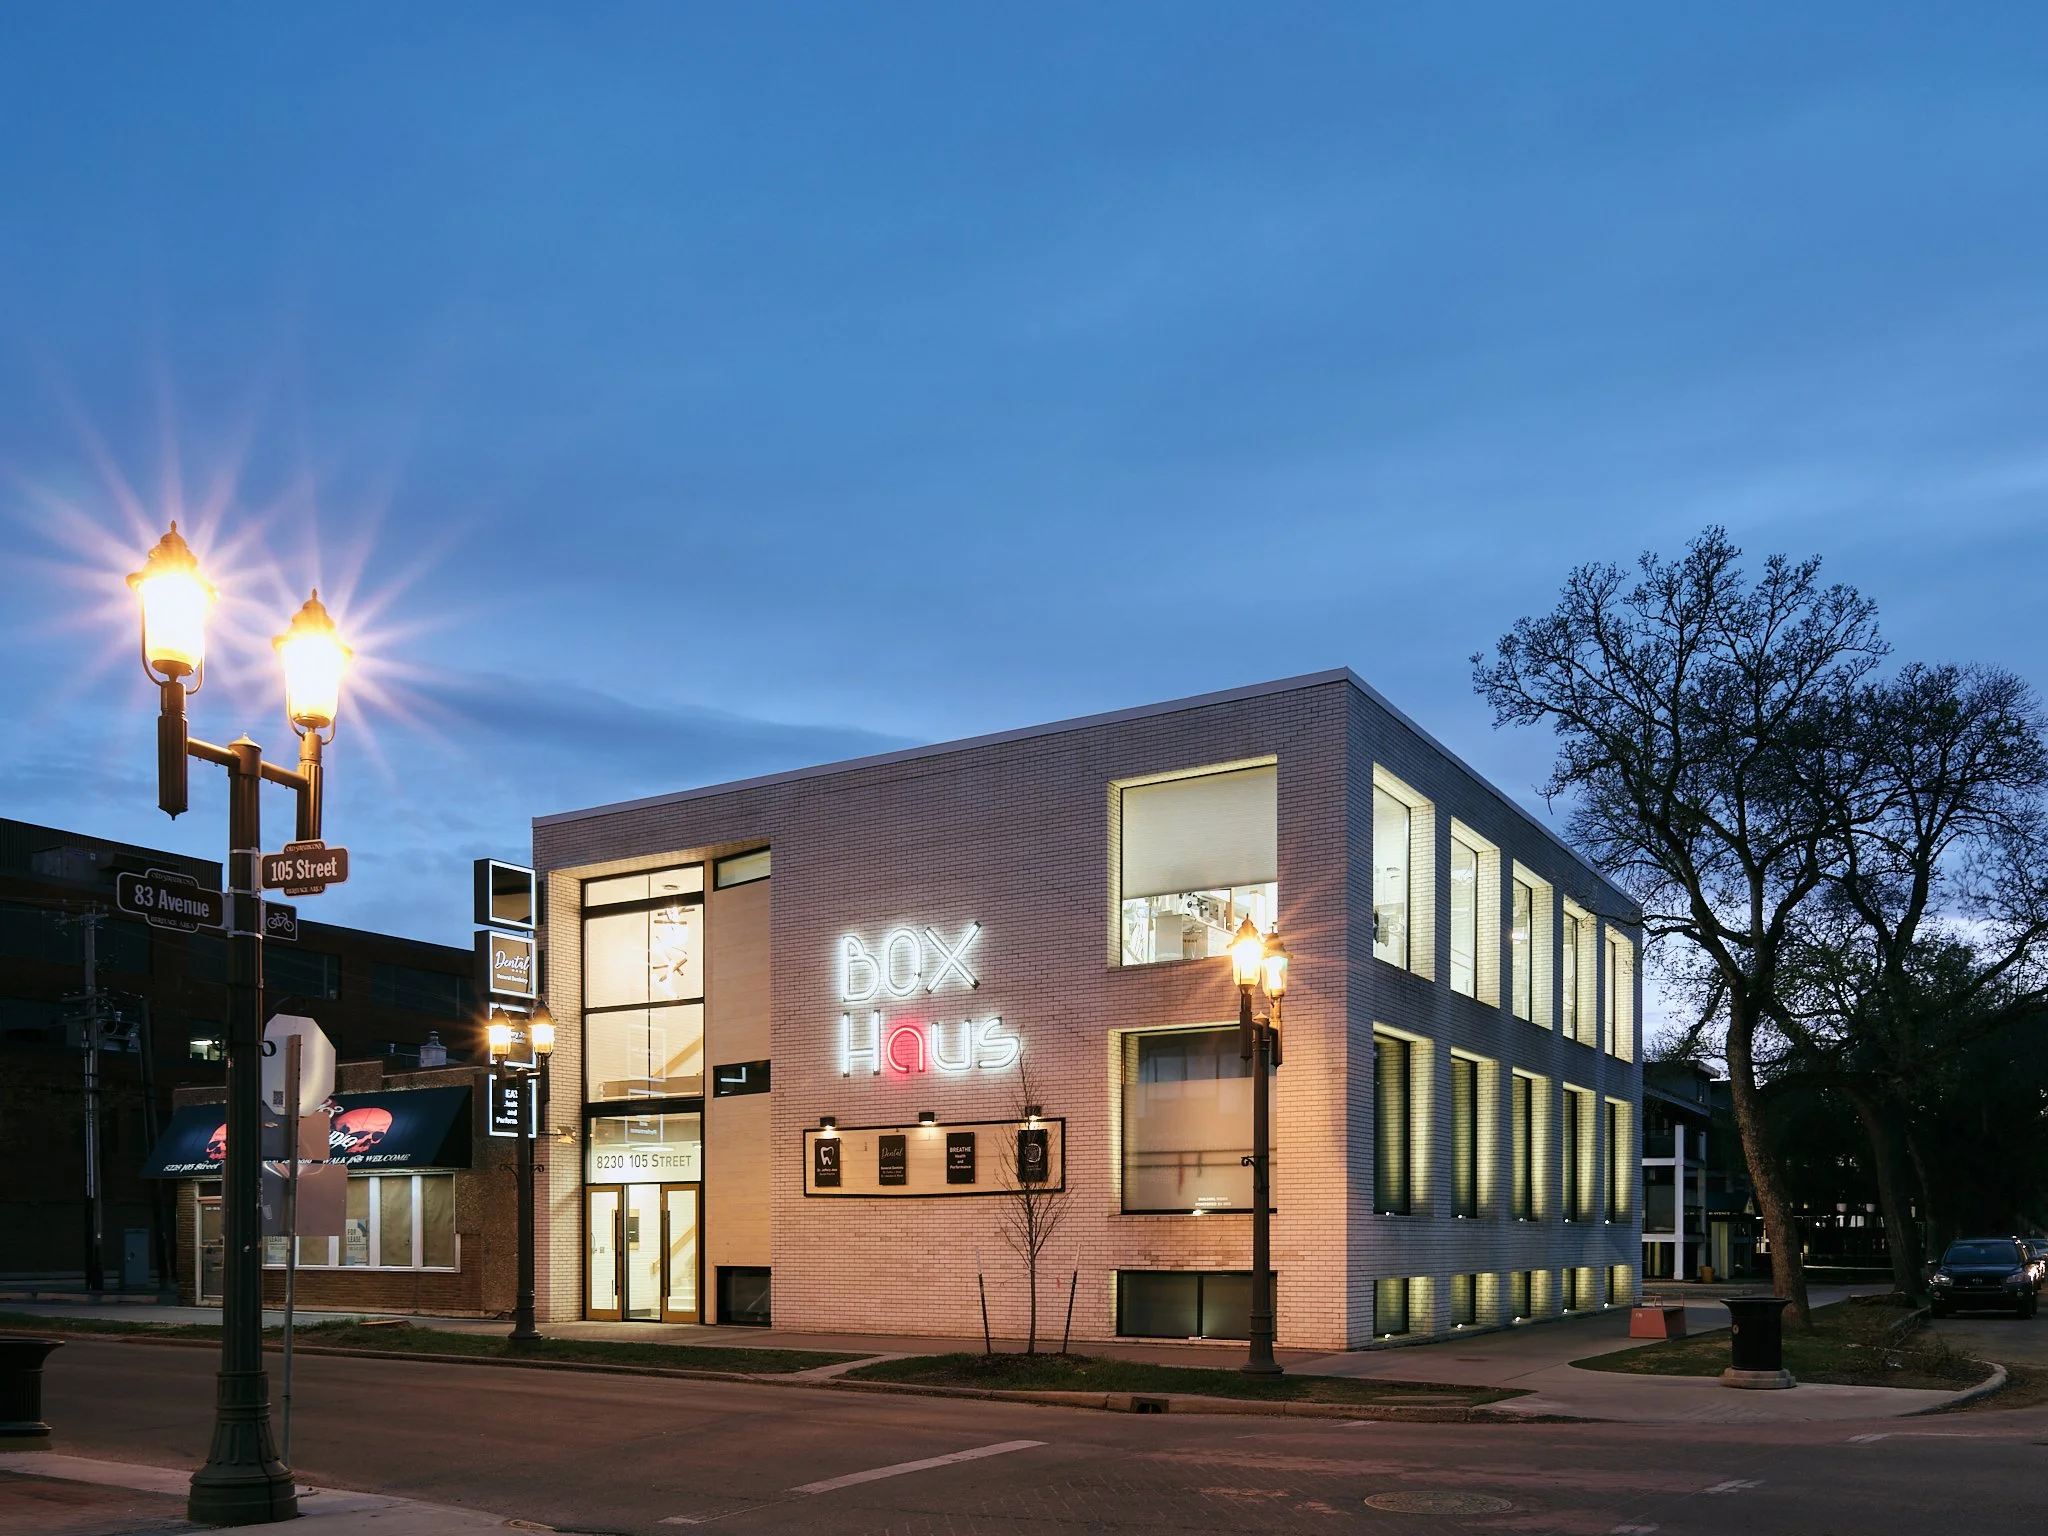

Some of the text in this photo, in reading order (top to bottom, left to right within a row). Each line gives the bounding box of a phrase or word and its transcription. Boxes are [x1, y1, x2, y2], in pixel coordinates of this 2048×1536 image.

[271, 856, 338, 882] 105 Street
[134, 884, 210, 918] 83 Avenue
[494, 950, 530, 970] Dental
[842, 920, 982, 1003] BOX
[365, 1154, 411, 1163] WELCOME
[596, 1155, 624, 1169] 8230
[629, 1154, 648, 1169] 105
[880, 1147, 904, 1160] Dental
